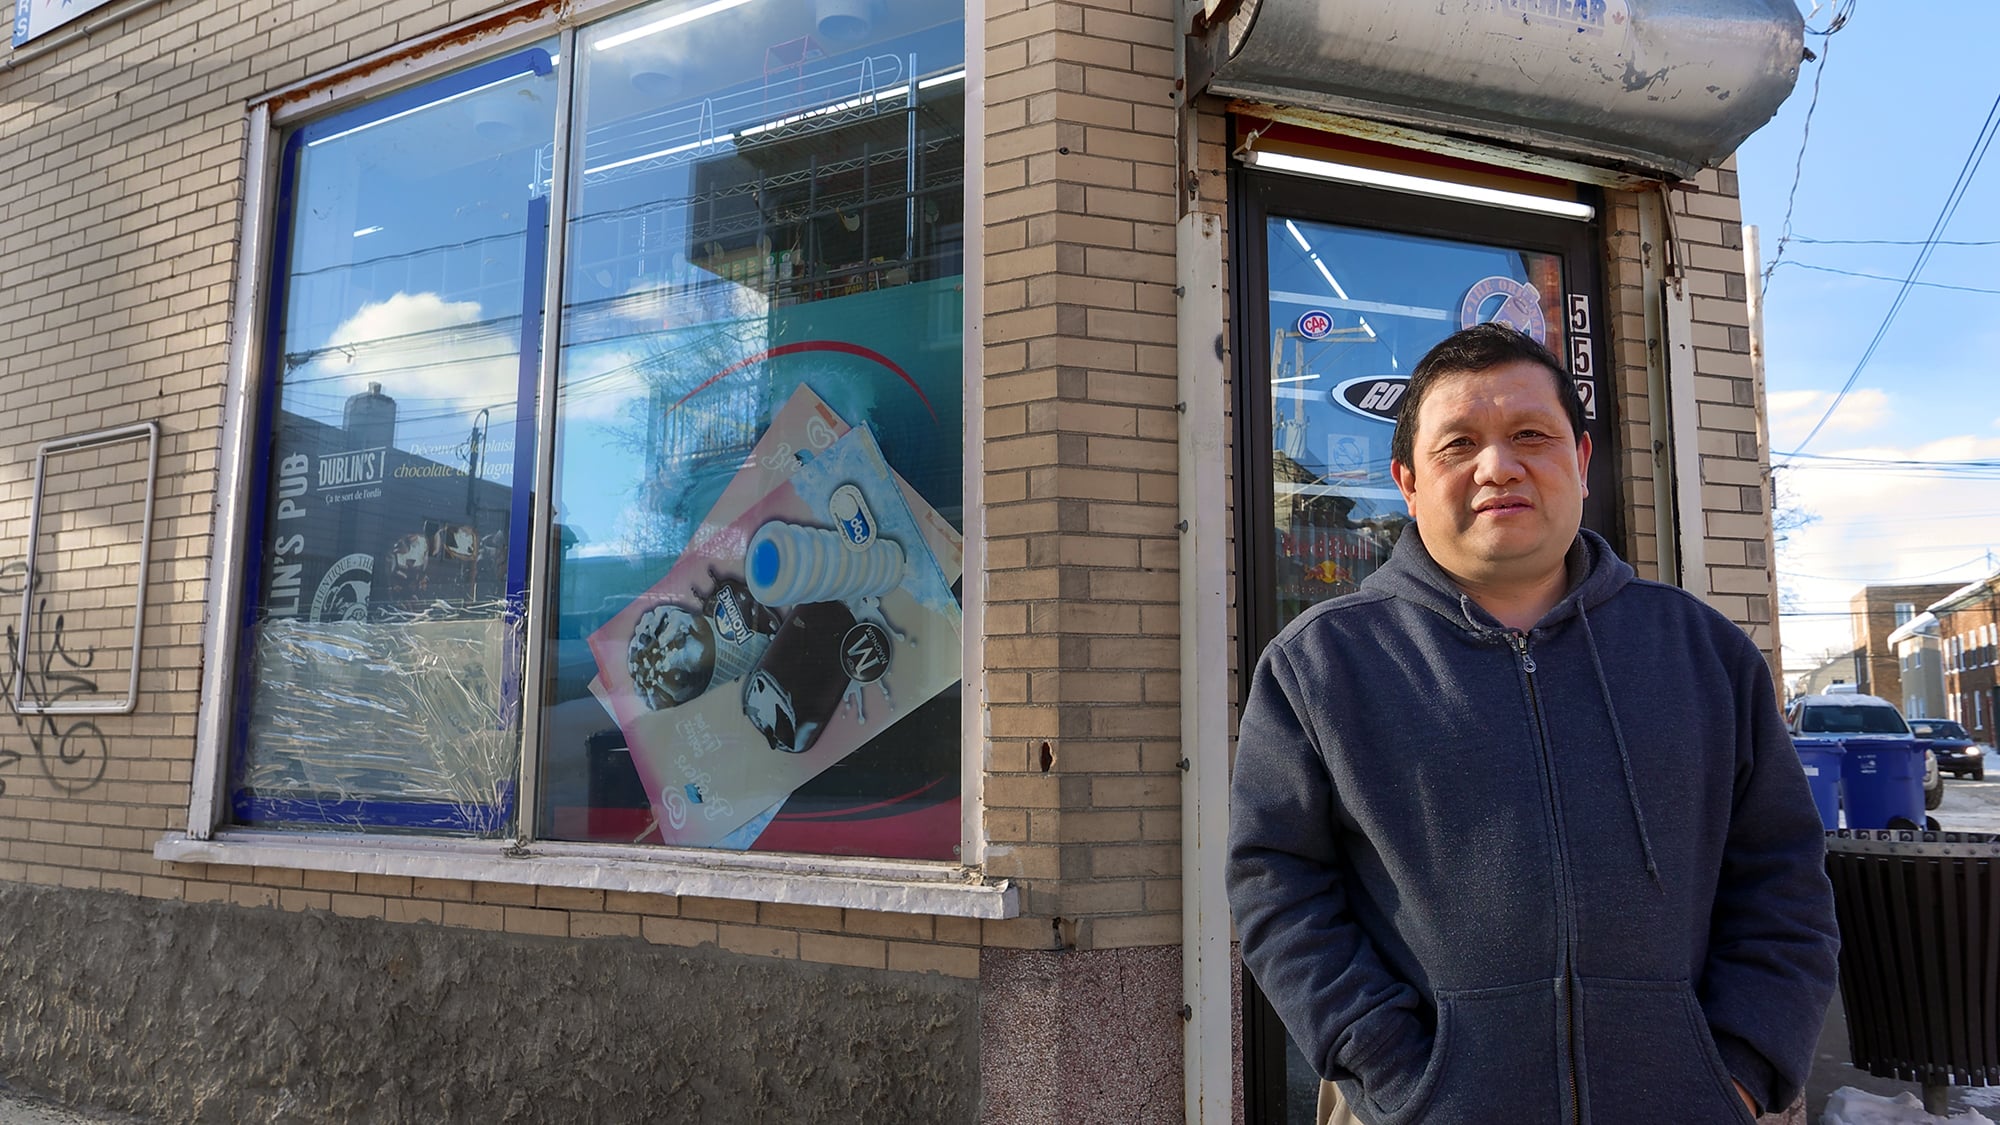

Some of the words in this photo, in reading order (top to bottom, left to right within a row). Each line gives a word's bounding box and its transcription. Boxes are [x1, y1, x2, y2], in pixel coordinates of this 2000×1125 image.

[1304, 316, 1327, 333] CAA
[277, 452, 309, 521] PUB
[318, 452, 375, 487] DUBLIN'S
[719, 587, 755, 645] KLONDIKE
[865, 626, 889, 665] MAGNUM
